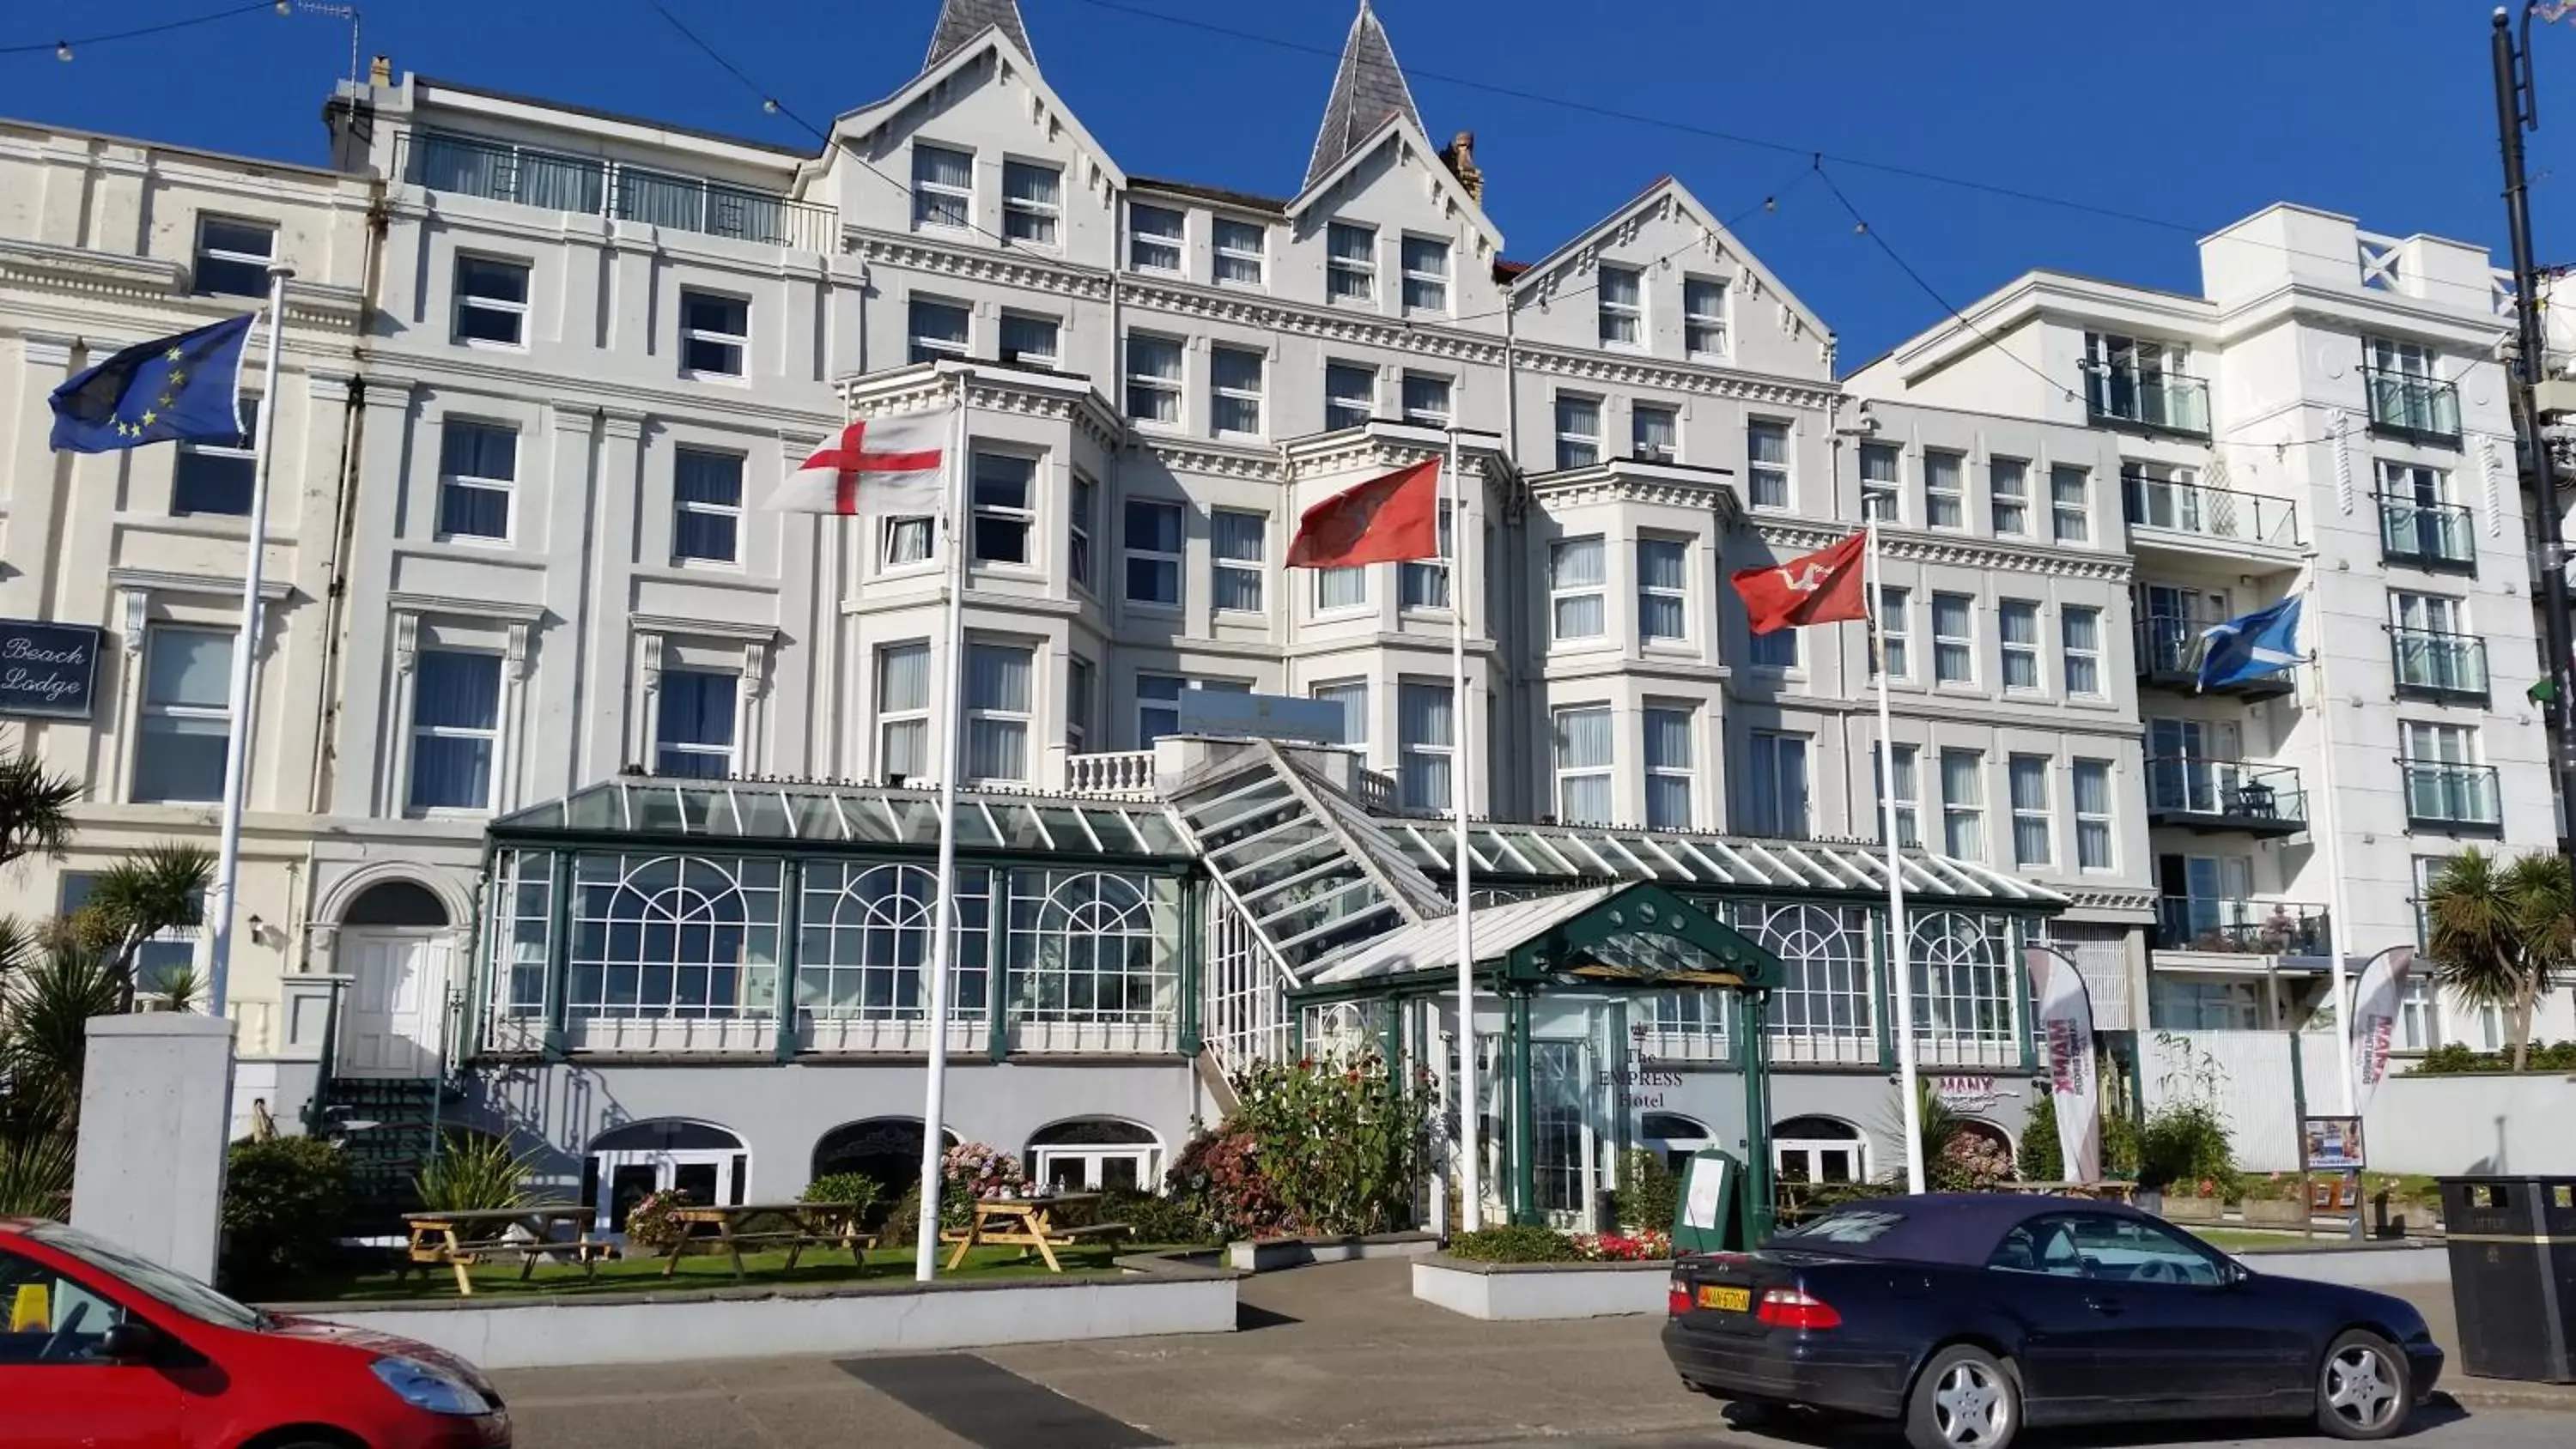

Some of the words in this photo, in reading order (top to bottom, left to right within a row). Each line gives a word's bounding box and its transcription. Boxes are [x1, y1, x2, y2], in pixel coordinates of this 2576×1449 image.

[2, 637, 85, 665] Beach
[1, 667, 82, 701] Lodge
[1625, 1048, 1657, 1064] The
[1599, 1070, 1683, 1087] EMPRESS
[1619, 1093, 1665, 1107] Hotel
